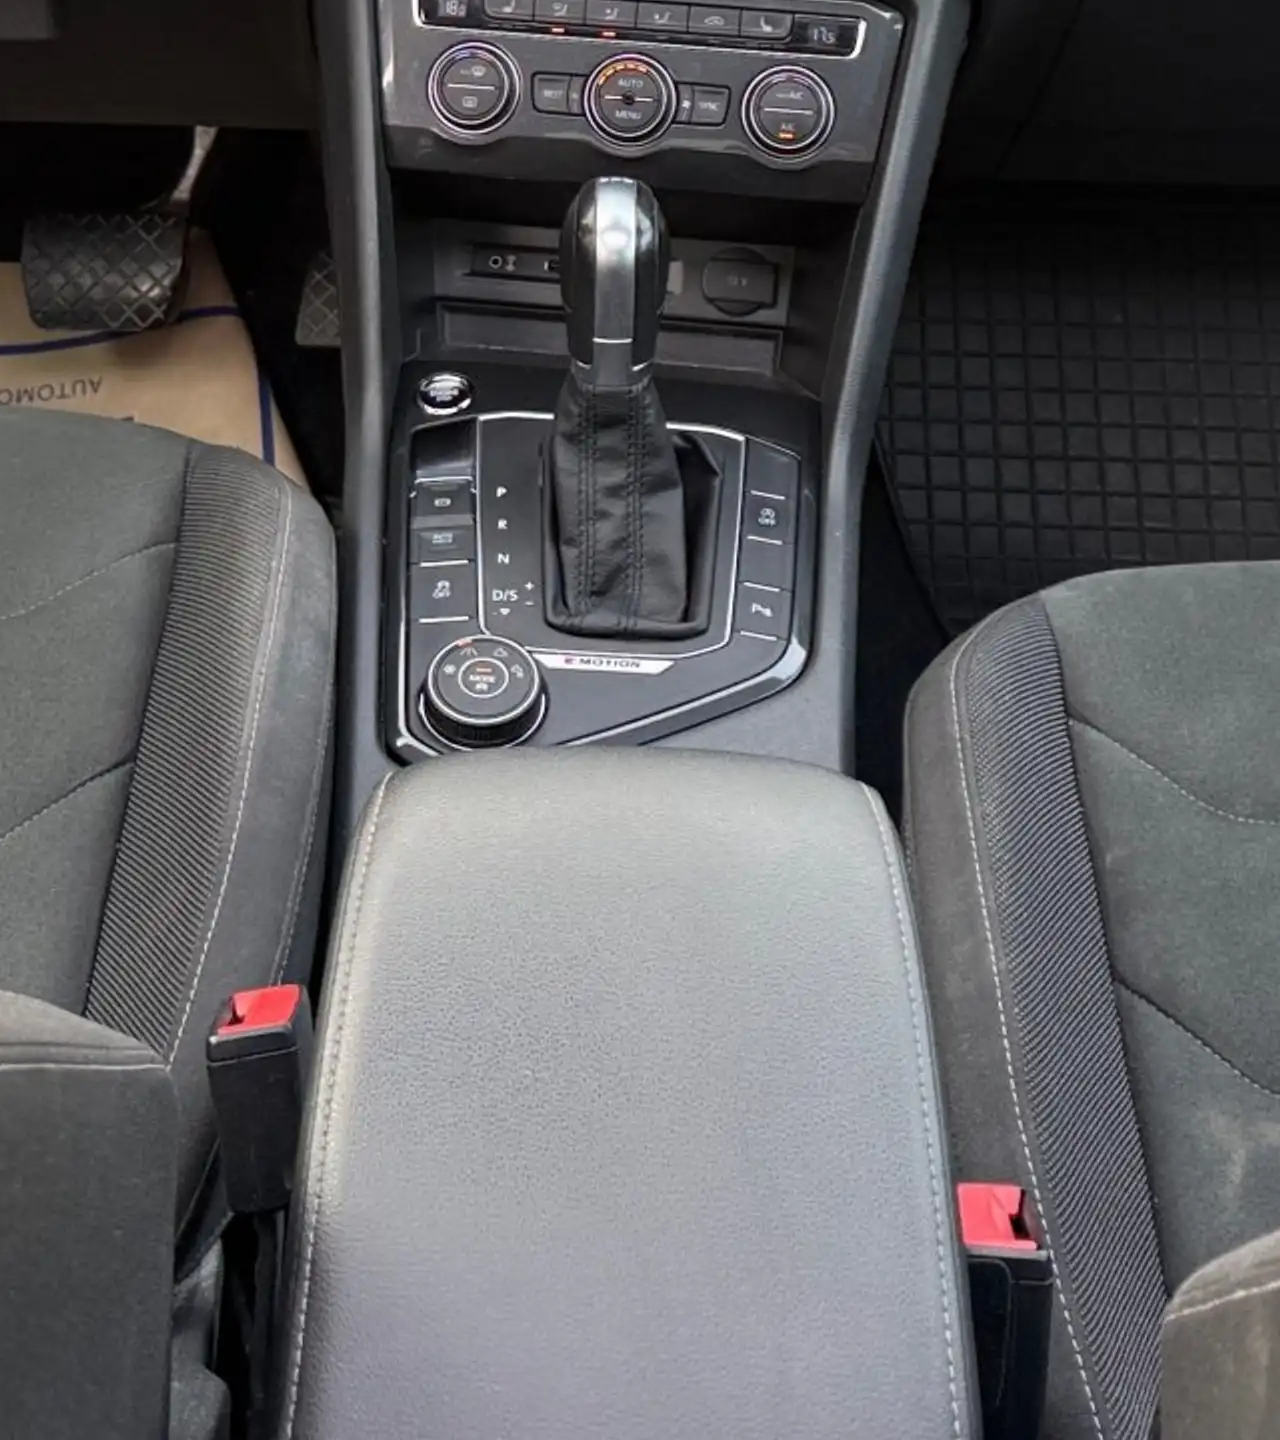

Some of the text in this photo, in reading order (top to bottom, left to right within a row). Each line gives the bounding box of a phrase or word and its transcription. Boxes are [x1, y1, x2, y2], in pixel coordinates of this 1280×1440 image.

[618, 78, 643, 89] AUTO
[615, 108, 642, 120] MENU
[496, 486, 508, 498] P
[497, 518, 508, 530] R
[497, 553, 510, 565] N
[492, 589, 518, 602] D/S
